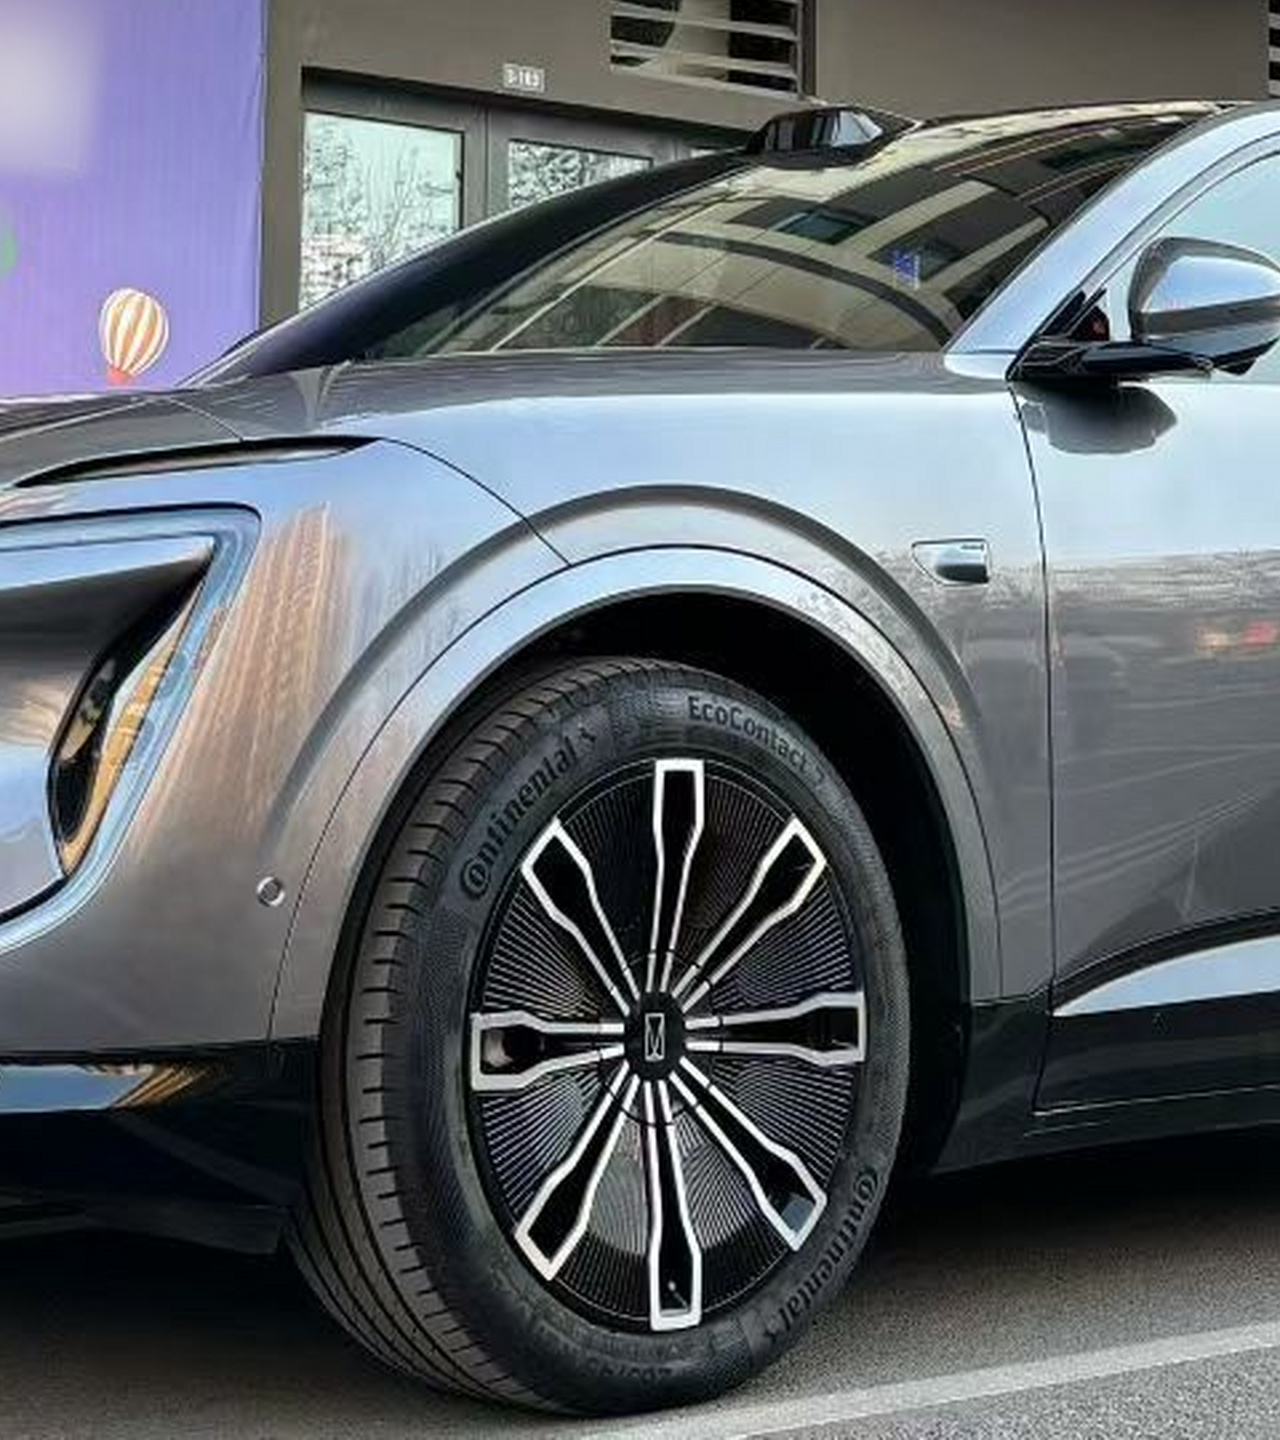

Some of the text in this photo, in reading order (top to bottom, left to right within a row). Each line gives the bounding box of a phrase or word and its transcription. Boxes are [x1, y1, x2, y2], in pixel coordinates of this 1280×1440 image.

[686, 694, 808, 773] EcoContact
[460, 734, 579, 899] Continental
[777, 1164, 880, 1333] Continental
